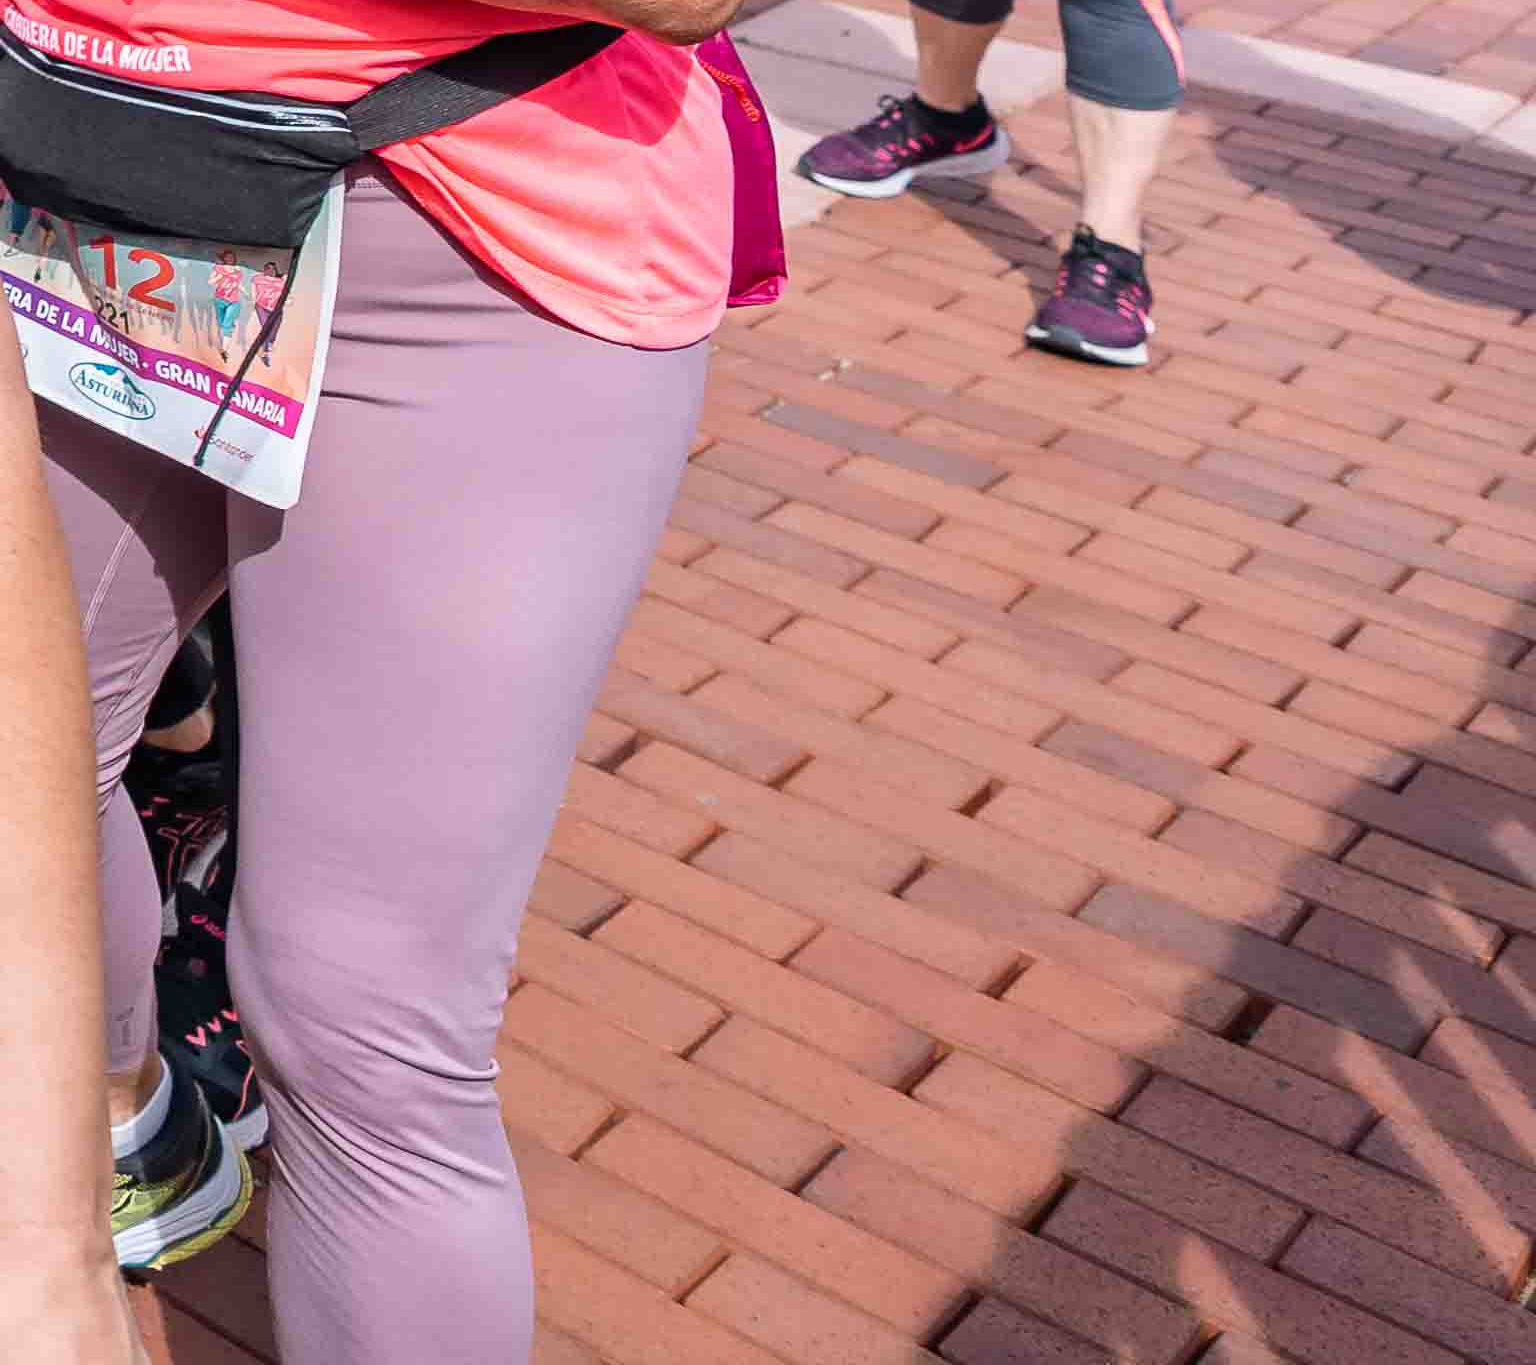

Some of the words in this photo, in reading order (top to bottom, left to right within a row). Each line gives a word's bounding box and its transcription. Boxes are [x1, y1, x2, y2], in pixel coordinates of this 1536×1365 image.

[64, 31, 88, 59] DE
[92, 37, 113, 66] LA
[119, 44, 192, 73] MUJER
[36, 300, 60, 325] DE
[63, 313, 86, 337] LA
[154, 359, 211, 394] GRAN
